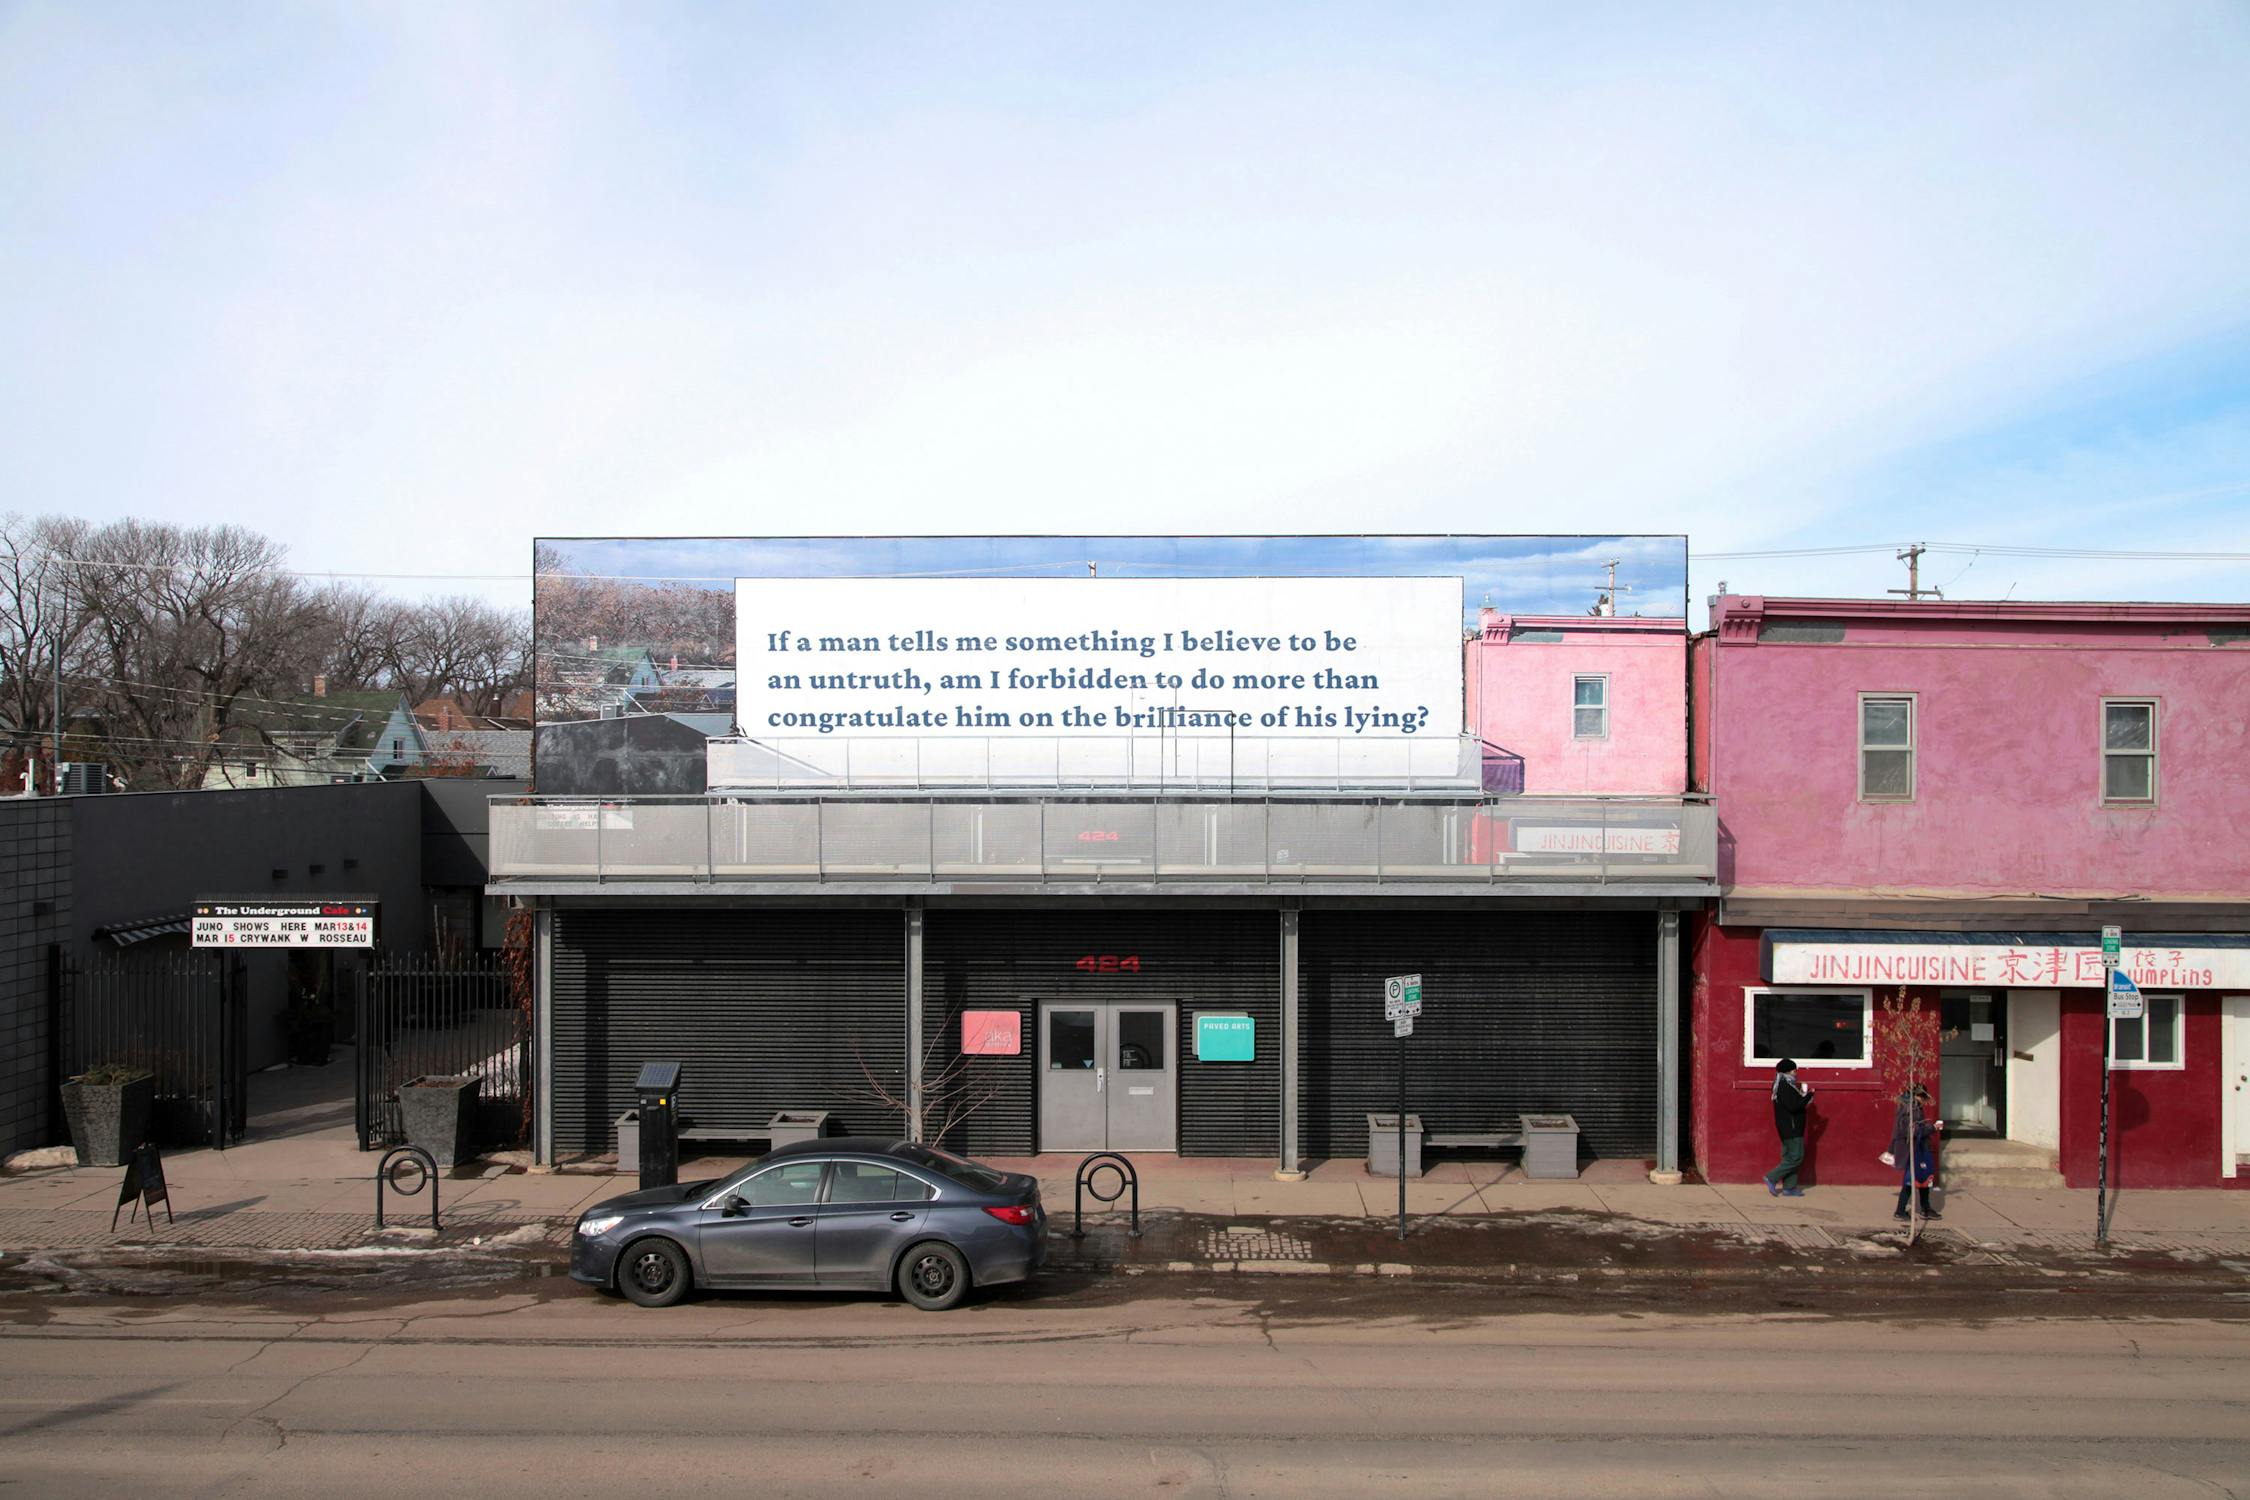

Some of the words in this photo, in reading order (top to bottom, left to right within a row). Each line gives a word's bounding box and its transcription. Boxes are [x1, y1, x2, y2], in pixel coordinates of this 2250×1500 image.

[769, 631, 789, 652] If
[797, 637, 812, 652] a
[820, 637, 880, 652] man
[889, 631, 949, 652] tells
[957, 637, 997, 651] me
[1006, 630, 1155, 658] something
[1165, 633, 1173, 652] I
[1183, 630, 1281, 652] believe
[1290, 634, 1317, 652] to
[1325, 630, 1357, 652] be
[768, 674, 801, 689] an
[810, 668, 932, 693] untruth,
[941, 674, 981, 689] am
[992, 671, 999, 689] I
[1010, 668, 1147, 689] forbidden
[1155, 672, 1183, 689] to
[1192, 668, 1225, 689] do
[1234, 674, 1305, 689] more
[1313, 668, 1380, 689] than
[768, 706, 947, 734] congratulate
[956, 706, 1010, 727] him
[1020, 713, 1054, 727] on
[1062, 706, 1107, 727] the
[1115, 706, 1253, 727] brilliance
[1261, 706, 1289, 727] of
[1296, 706, 1338, 727] his
[1345, 706, 1429, 734] lying?
[1077, 831, 1120, 842] 424
[215, 906, 238, 915] The
[240, 906, 321, 917] Underground
[322, 906, 350, 915] Cafe
[197, 922, 223, 931] JUNO
[233, 922, 269, 931] SHOWS
[281, 922, 307, 931] HERE
[197, 934, 219, 943] MAR
[241, 934, 291, 943] CRYWANK
[301, 934, 309, 943] W
[320, 934, 367, 943] ROSSEAU
[1077, 956, 1139, 972] 424
[2113, 992, 2124, 1000] Bus
[2125, 992, 2139, 1001] Stop
